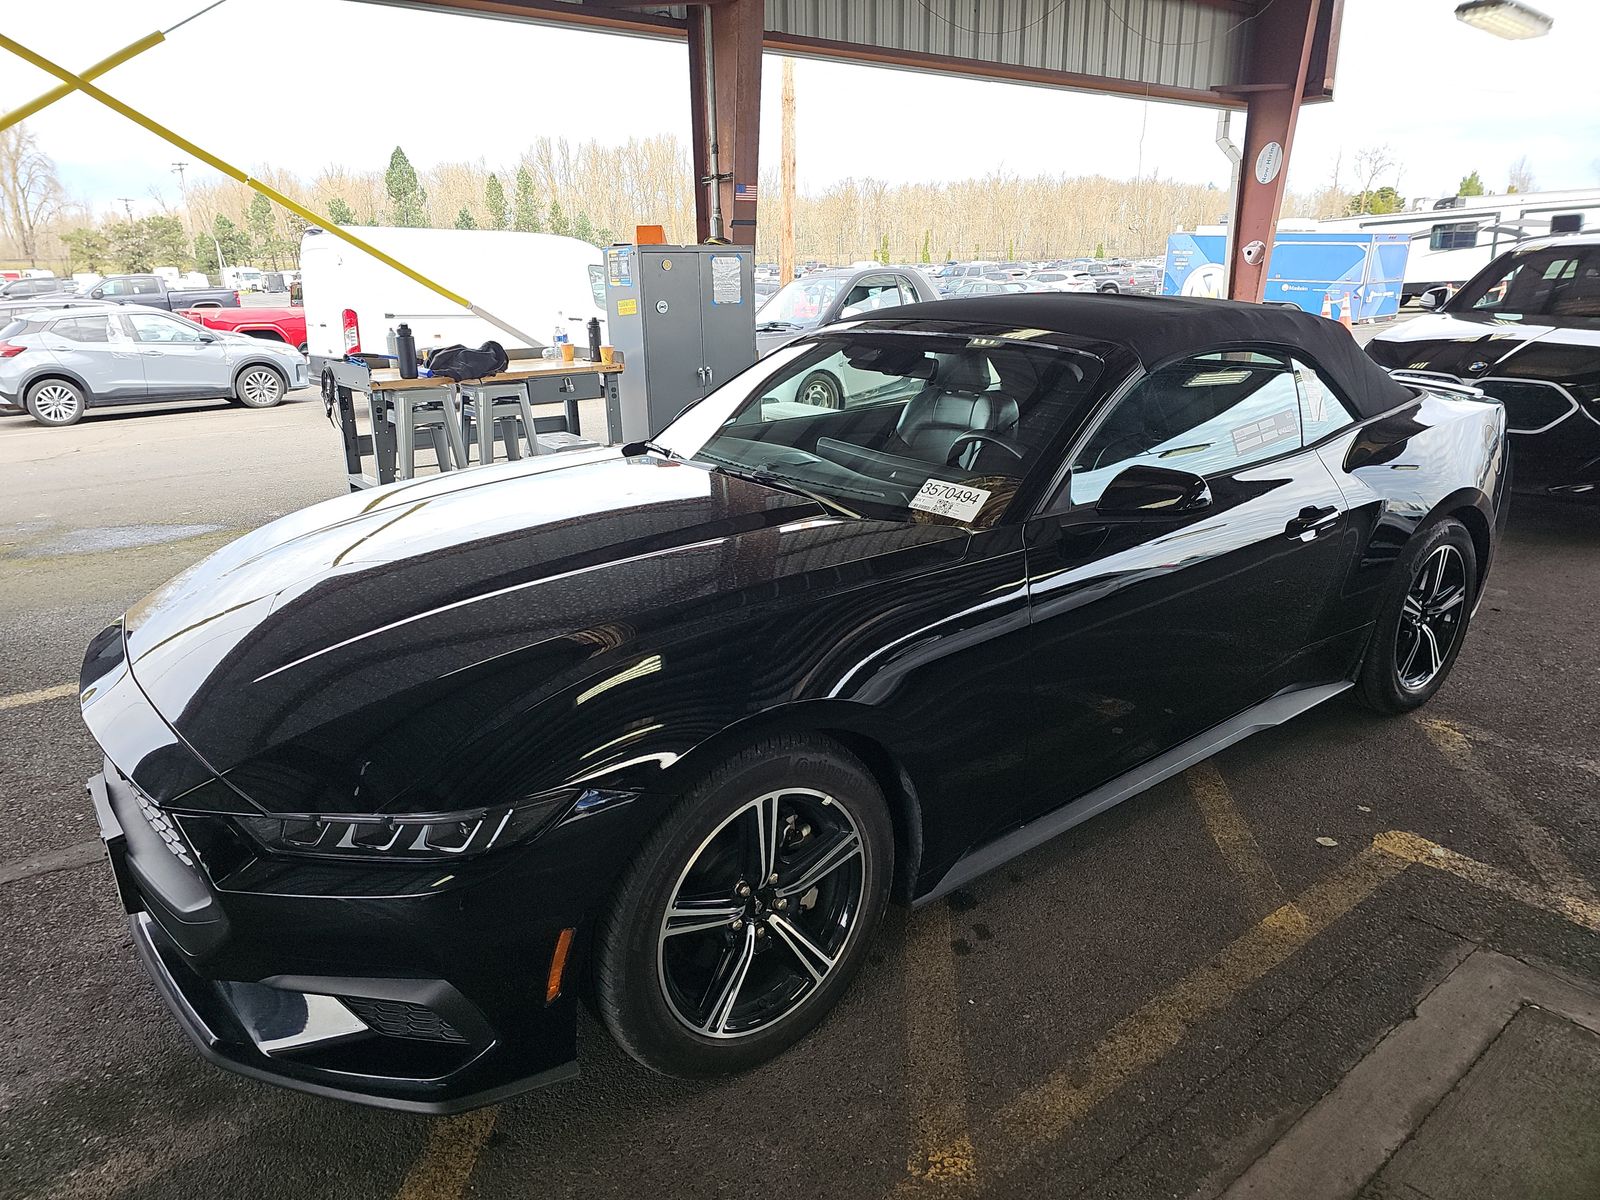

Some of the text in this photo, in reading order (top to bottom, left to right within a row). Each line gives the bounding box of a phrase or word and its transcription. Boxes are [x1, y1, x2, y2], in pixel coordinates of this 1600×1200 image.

[1261, 143, 1277, 183] Now Hiring
[921, 482, 981, 505] 3570494
